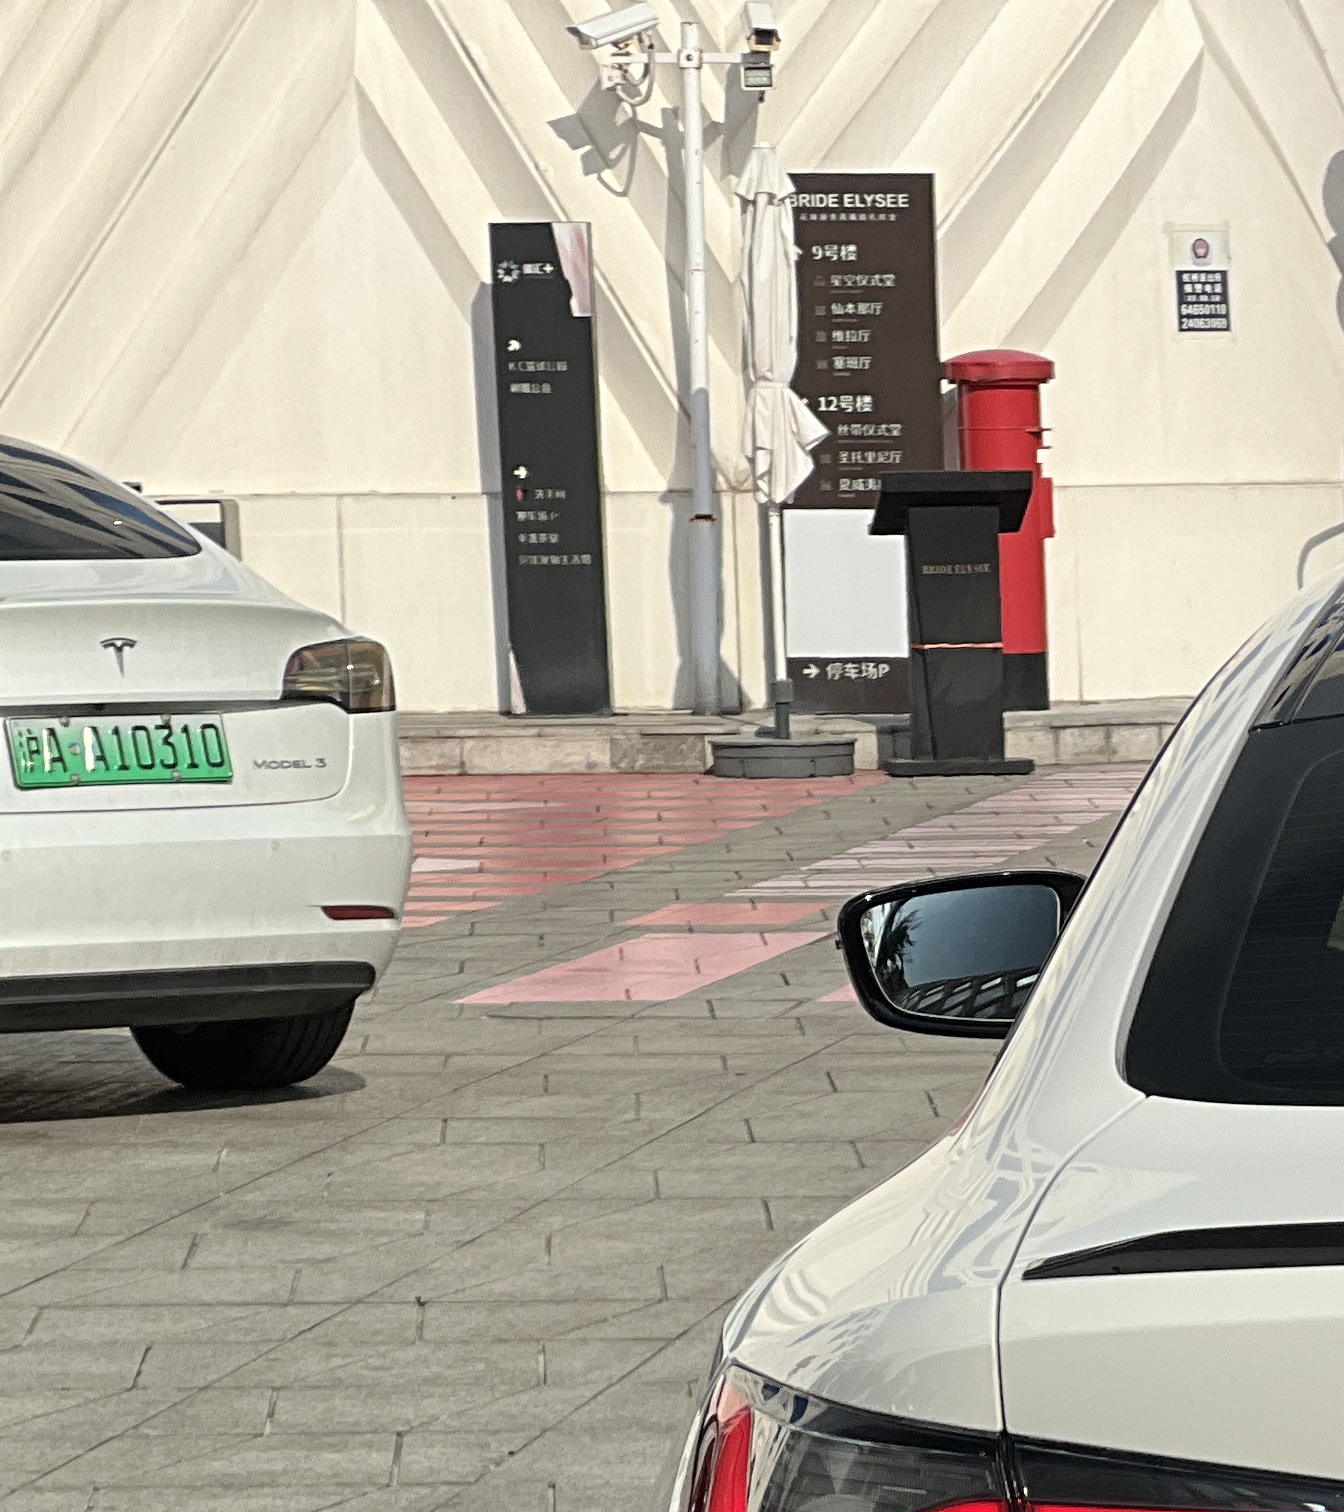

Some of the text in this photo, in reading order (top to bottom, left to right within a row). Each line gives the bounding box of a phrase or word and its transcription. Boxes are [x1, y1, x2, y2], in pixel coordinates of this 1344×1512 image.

[789, 193, 910, 208] BRIDE ELYSEE
[811, 244, 859, 261] 9号楼
[817, 395, 874, 412] 12号楼
[838, 478, 881, 491] 夏威夷
[253, 757, 327, 770] MODEL 3
